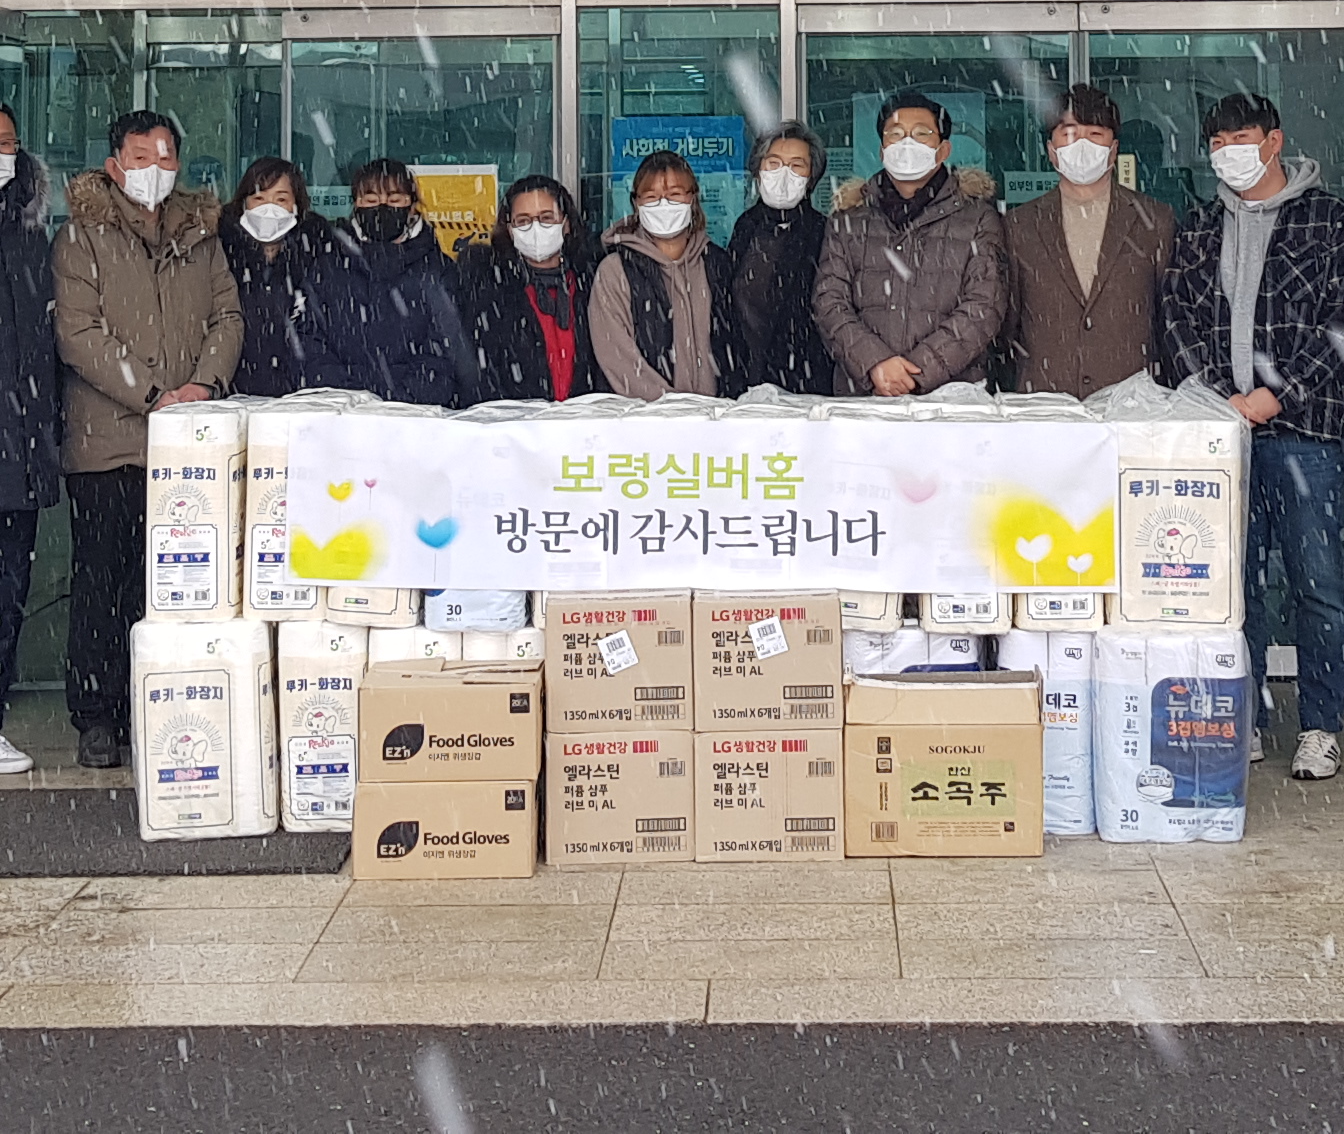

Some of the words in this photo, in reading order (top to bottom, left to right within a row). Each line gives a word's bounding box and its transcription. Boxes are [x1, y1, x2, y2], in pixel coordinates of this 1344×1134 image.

[673, 137, 733, 157] 거리두기
[553, 452, 804, 500] 보령실버홈
[1128, 479, 1220, 499] 루키-화장지
[494, 508, 619, 555] 방문에
[630, 508, 886, 556] 감사드립니다
[446, 604, 462, 615] 30
[563, 633, 613, 649] 엘라스
[564, 668, 584, 680] 러브
[588, 668, 596, 679] 미
[712, 666, 733, 678] 러브
[736, 666, 746, 678] 미
[749, 666, 764, 676] AL
[1046, 692, 1079, 710] 데코
[564, 711, 587, 720] 1350
[713, 708, 736, 719] 1350
[428, 734, 464, 748] Food
[466, 733, 514, 748] Gloves
[928, 746, 986, 754] SOGOKJU
[564, 764, 620, 781] 엘라스틴
[713, 762, 769, 780] 엘라스틴
[910, 781, 1007, 806] 소곡주
[564, 800, 585, 812] 러브
[588, 800, 598, 812] 미
[602, 800, 616, 810] AL
[714, 798, 734, 810] 러브
[738, 798, 747, 809] 미
[750, 798, 766, 808] AL
[1120, 810, 1138, 823] 30
[423, 831, 460, 846] Food
[462, 830, 510, 844] Gloves
[564, 843, 588, 854] 1350
[713, 842, 737, 852] 1350
